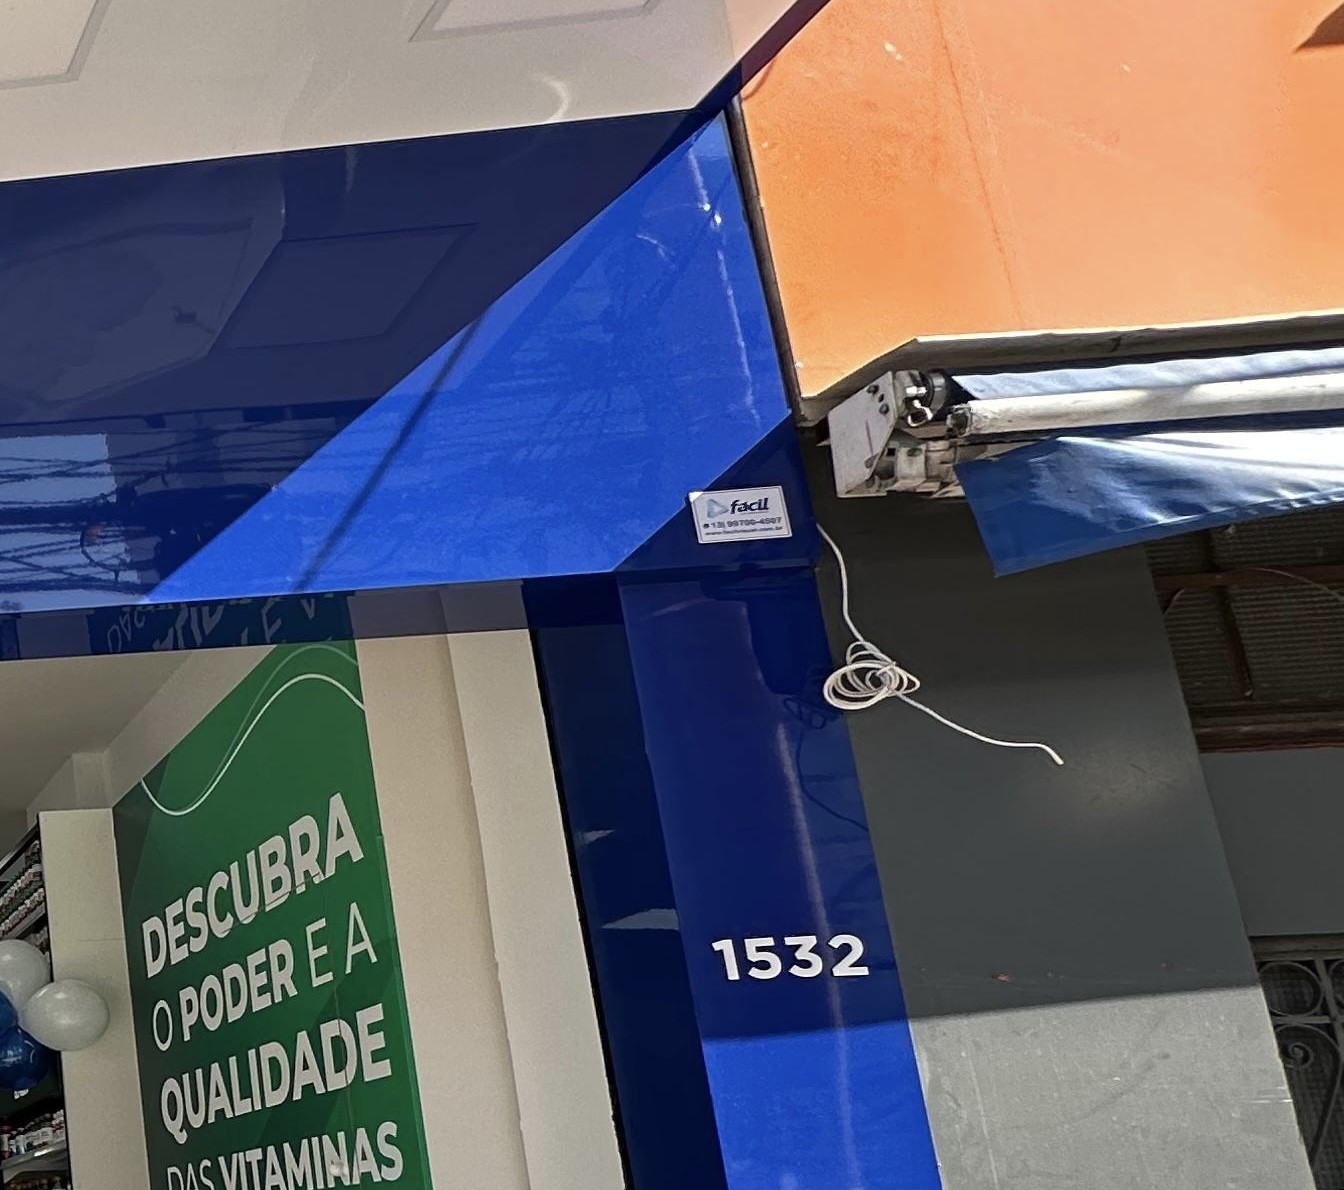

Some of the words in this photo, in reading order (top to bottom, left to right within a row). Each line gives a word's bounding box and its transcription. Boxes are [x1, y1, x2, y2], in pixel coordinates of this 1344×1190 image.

[142, 792, 364, 979] DESCUBRA
[712, 934, 869, 981] 1532
[152, 999, 173, 1052] O
[179, 939, 298, 1043] PODER
[305, 917, 334, 988] E
[344, 902, 378, 974] A
[161, 1003, 392, 1144] QUALIDADE
